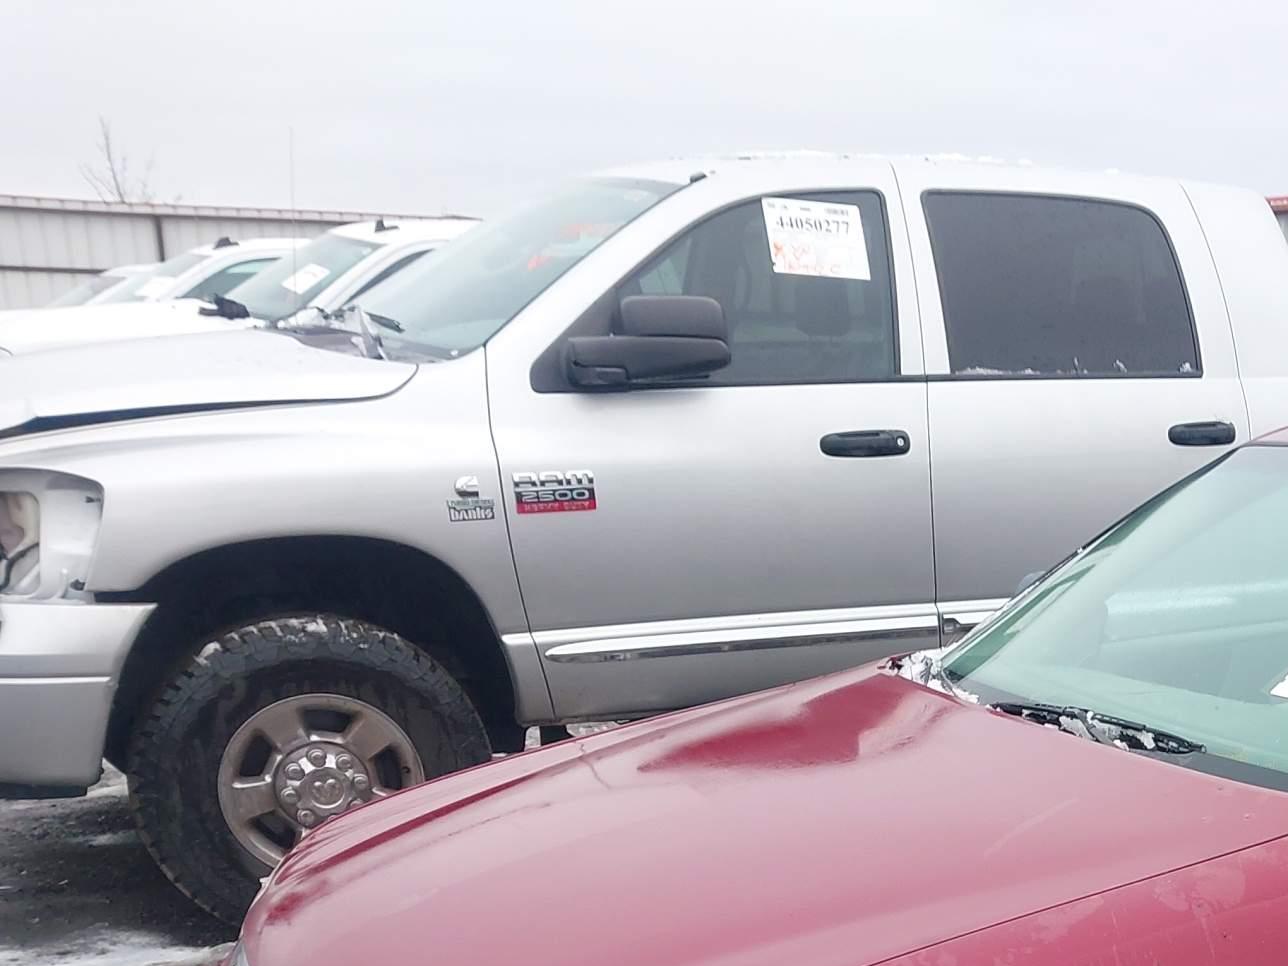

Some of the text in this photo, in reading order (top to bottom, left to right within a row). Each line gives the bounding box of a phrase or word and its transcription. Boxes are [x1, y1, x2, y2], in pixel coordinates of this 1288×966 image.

[775, 216, 850, 235] 44050277
[512, 470, 594, 488] RAM
[520, 489, 590, 503] 2500
